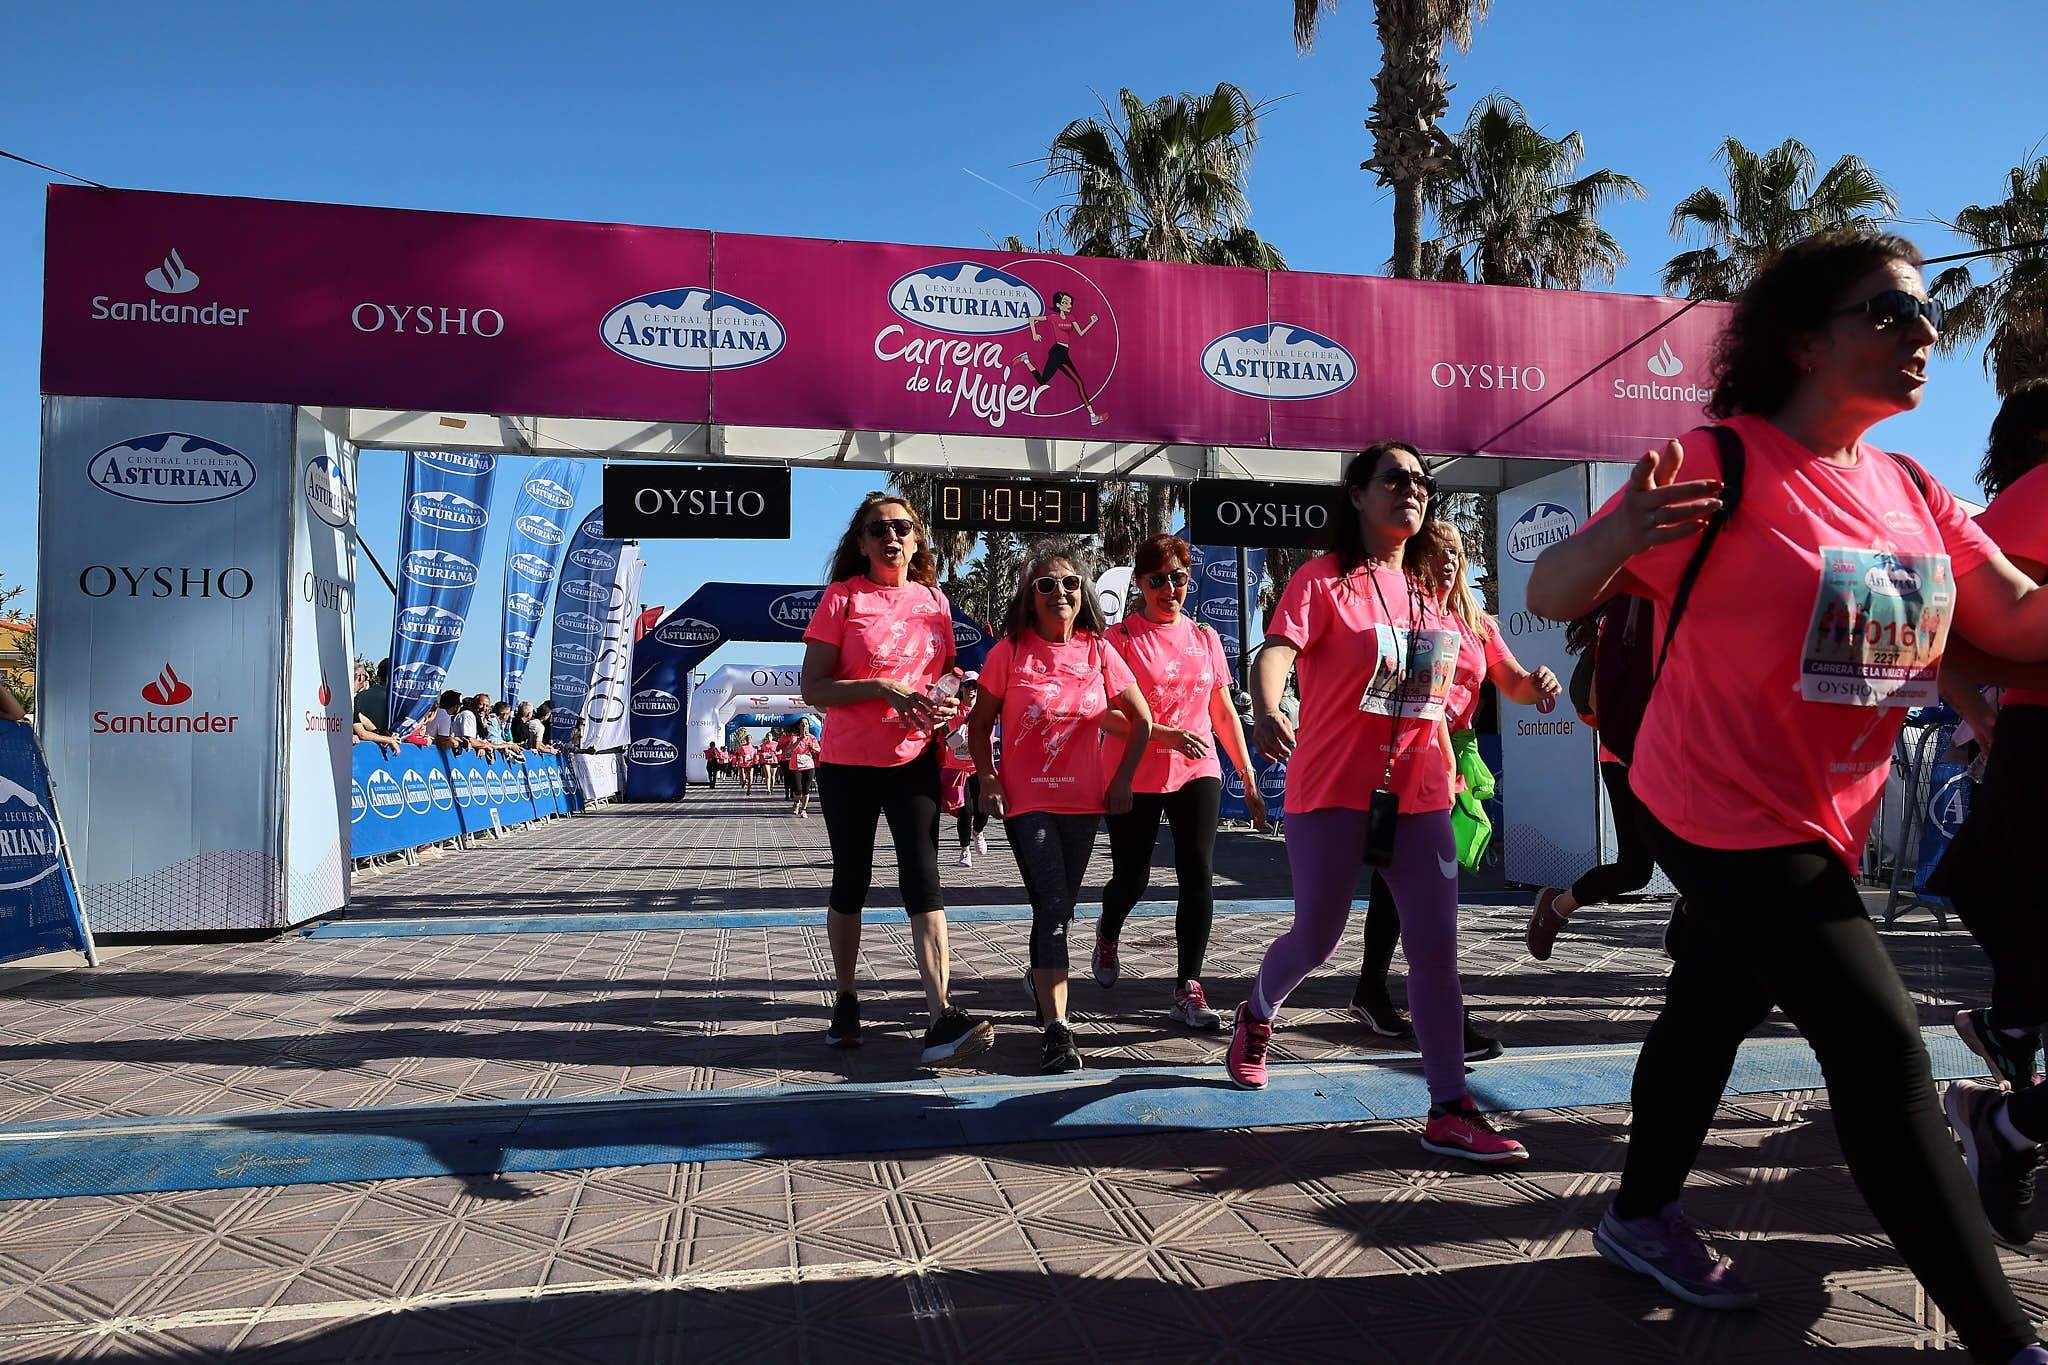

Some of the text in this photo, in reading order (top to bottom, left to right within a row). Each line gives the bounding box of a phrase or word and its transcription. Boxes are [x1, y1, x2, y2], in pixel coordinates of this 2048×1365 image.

[901, 284, 1032, 319] ASTURIANA
[925, 283, 1028, 298] CENTRAL LECHERA
[91, 295, 249, 326] Santander
[351, 302, 504, 338] OYSHO
[644, 313, 702, 325] CENTRAL
[614, 314, 772, 351] ASTURIANA
[874, 324, 1004, 369] Carrera
[1237, 347, 1340, 360] CENTRAL LECHERA
[1212, 348, 1346, 382] ASTURIANA
[1431, 361, 1546, 392] OYSHO
[906, 365, 1051, 427] de la Mujer
[1614, 378, 1715, 402] Santander
[100, 456, 243, 487] ASTURIANA
[128, 456, 239, 466] CENTRAL LECHERA
[529, 484, 570, 507] ASTURIANA
[634, 488, 765, 517] OYSHO
[943, 487, 1086, 523] 01:04:31
[411, 499, 482, 525] ASTURIANA
[1217, 500, 1328, 529] OYSHO
[1511, 524, 1570, 554] ASTURIANA
[79, 565, 253, 599] OYSHO
[405, 560, 474, 583] ASTURIANA
[303, 571, 349, 614] OYSHO
[659, 629, 715, 640] ASTURIANA
[1811, 662, 1854, 674] CARRERA
[1873, 653, 1900, 665] 2237
[1817, 680, 1873, 697] OYSHO
[631, 699, 677, 711] ASTURIANA
[93, 711, 239, 733] Santander
[304, 710, 344, 733] Santander
[1517, 719, 1575, 737] Santander
[630, 747, 675, 759] ASTURIANA
